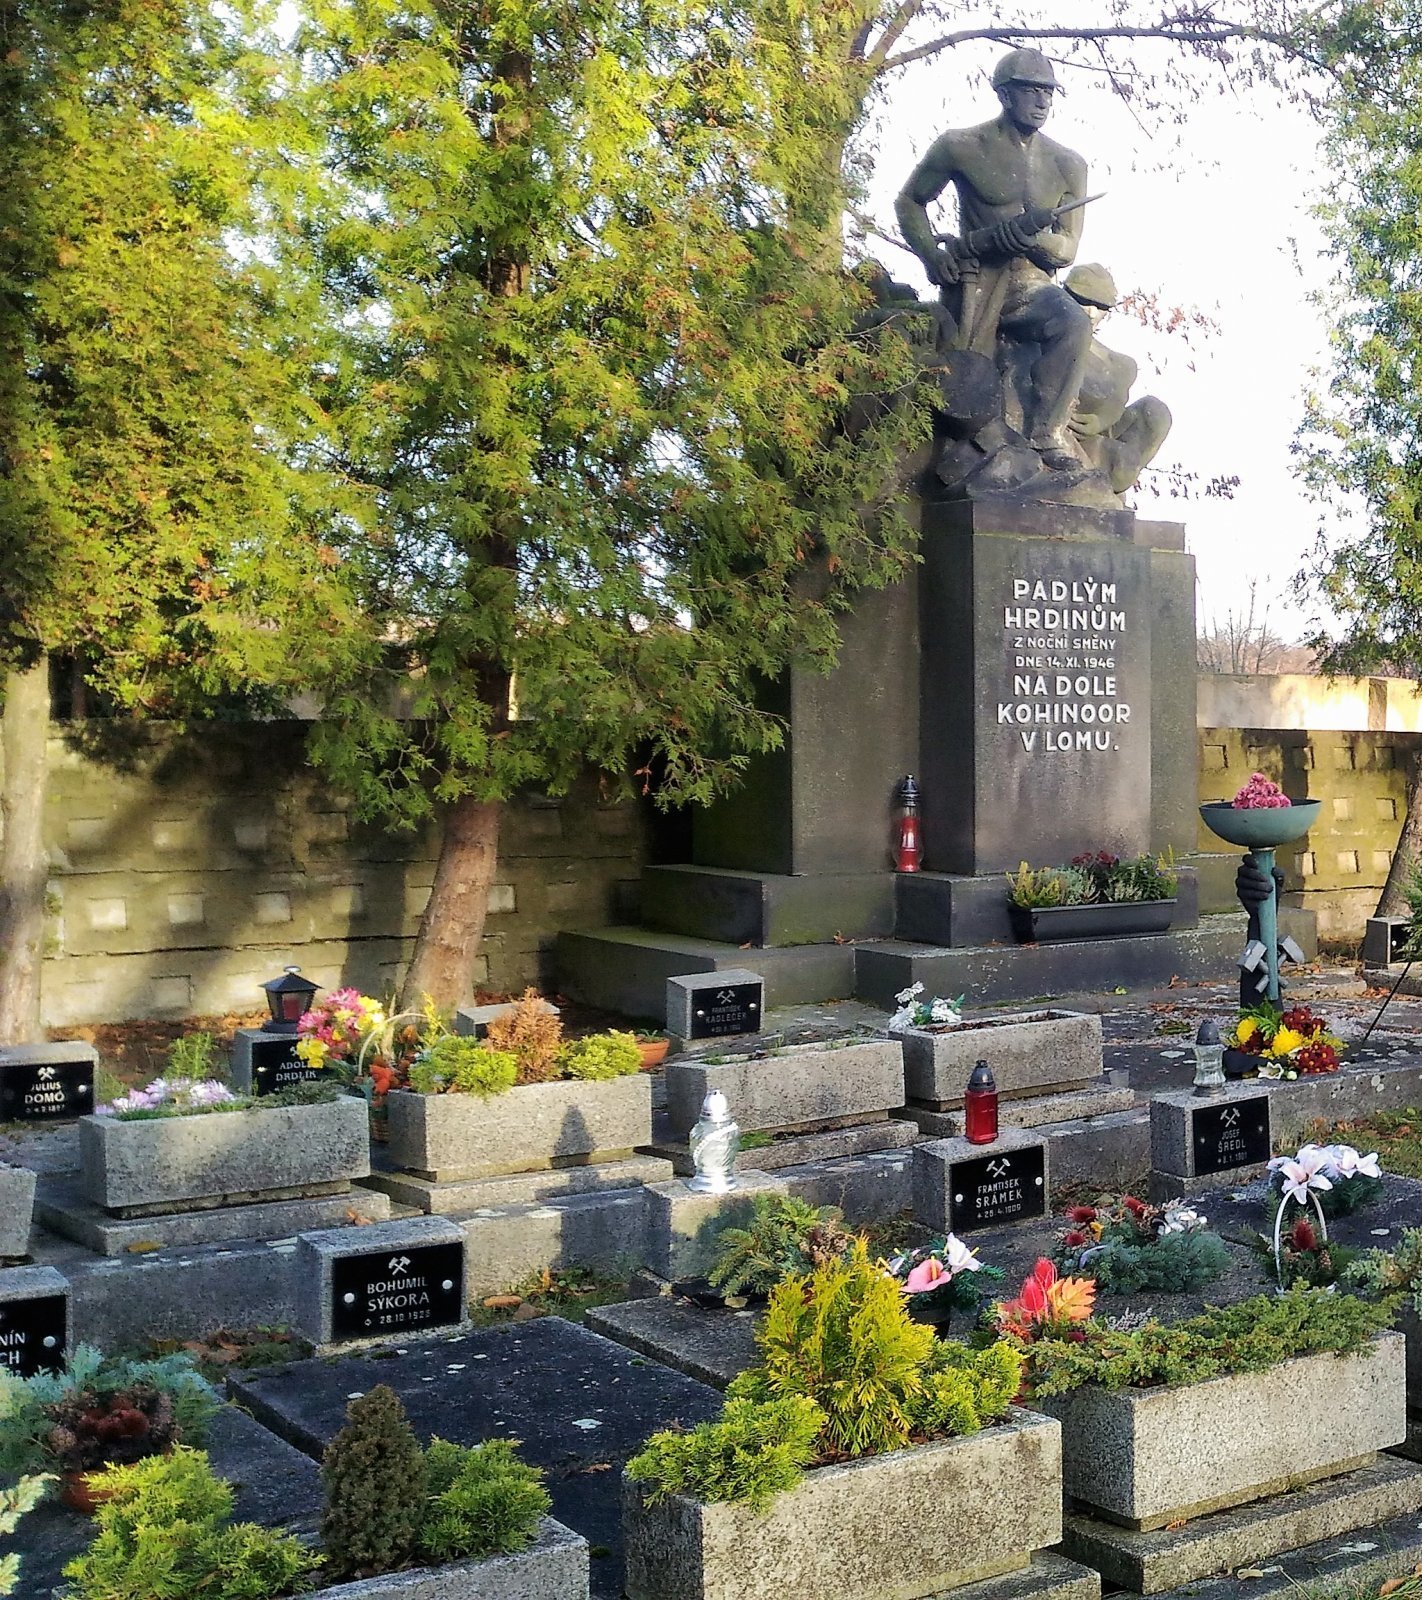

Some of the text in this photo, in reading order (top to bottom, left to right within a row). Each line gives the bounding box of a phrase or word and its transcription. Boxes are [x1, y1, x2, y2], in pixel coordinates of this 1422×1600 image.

[1012, 576, 1117, 605] PADLÝM
[1003, 604, 1127, 632] HRDINŮM
[1014, 637, 1024, 649] Z
[1072, 634, 1117, 651] SMĚNY
[1015, 655, 1043, 669] DNE
[1013, 674, 1118, 697] NA DOLE
[996, 702, 1132, 725] KOHINOOR
[1020, 730, 1119, 752] V LOMU.
[31, 1081, 62, 1093] JULIUS
[1221, 1128, 1240, 1140] JOSEF
[367, 1277, 428, 1294] BOHUMIL
[368, 1291, 430, 1312] SÝKORA
